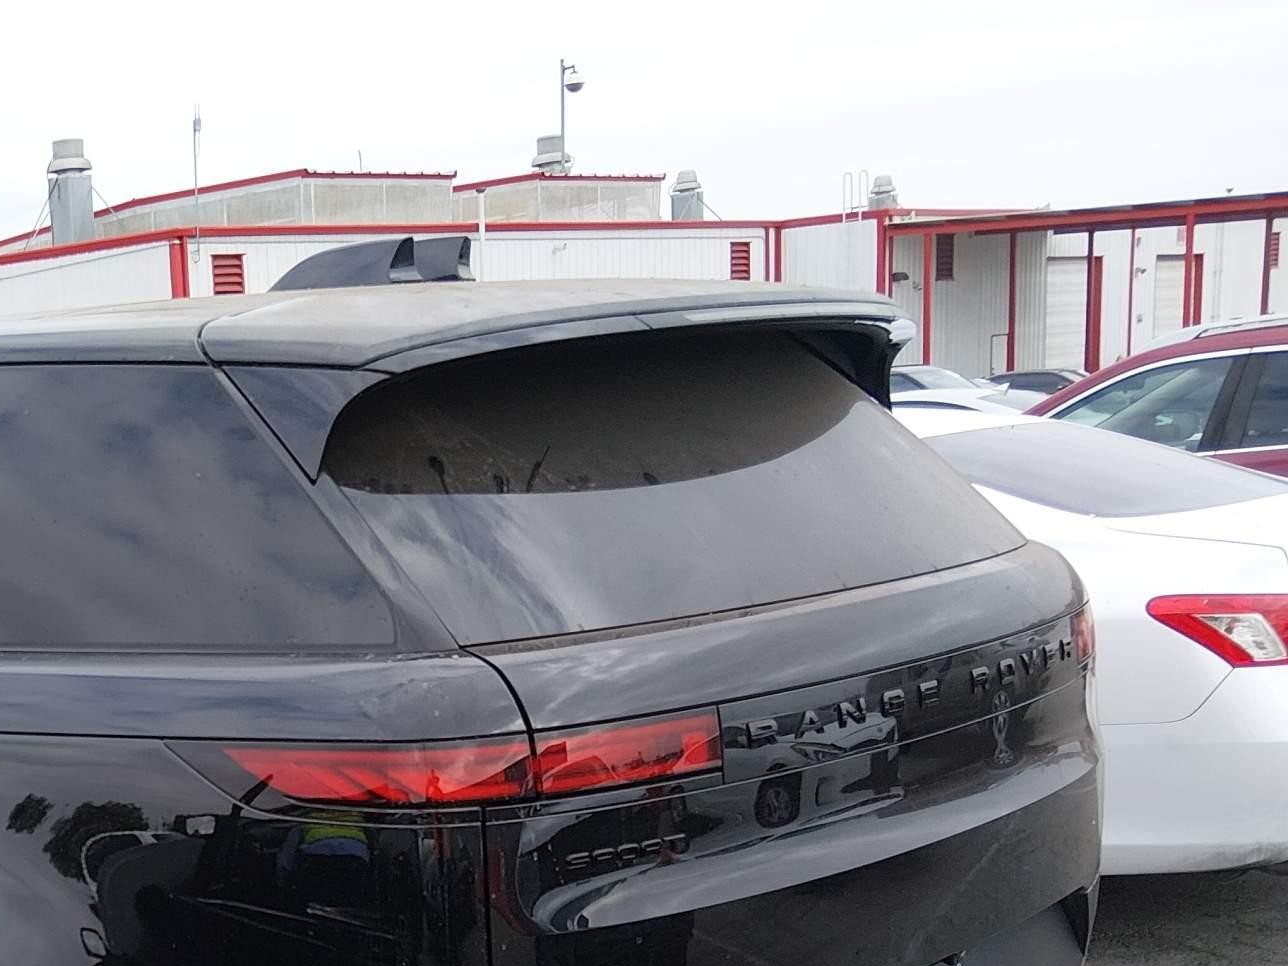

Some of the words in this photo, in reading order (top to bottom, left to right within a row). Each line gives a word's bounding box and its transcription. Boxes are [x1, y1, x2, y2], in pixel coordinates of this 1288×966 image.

[745, 680, 941, 749] RANGE
[969, 638, 1073, 695] ROVER
[564, 832, 688, 872] SPORT
